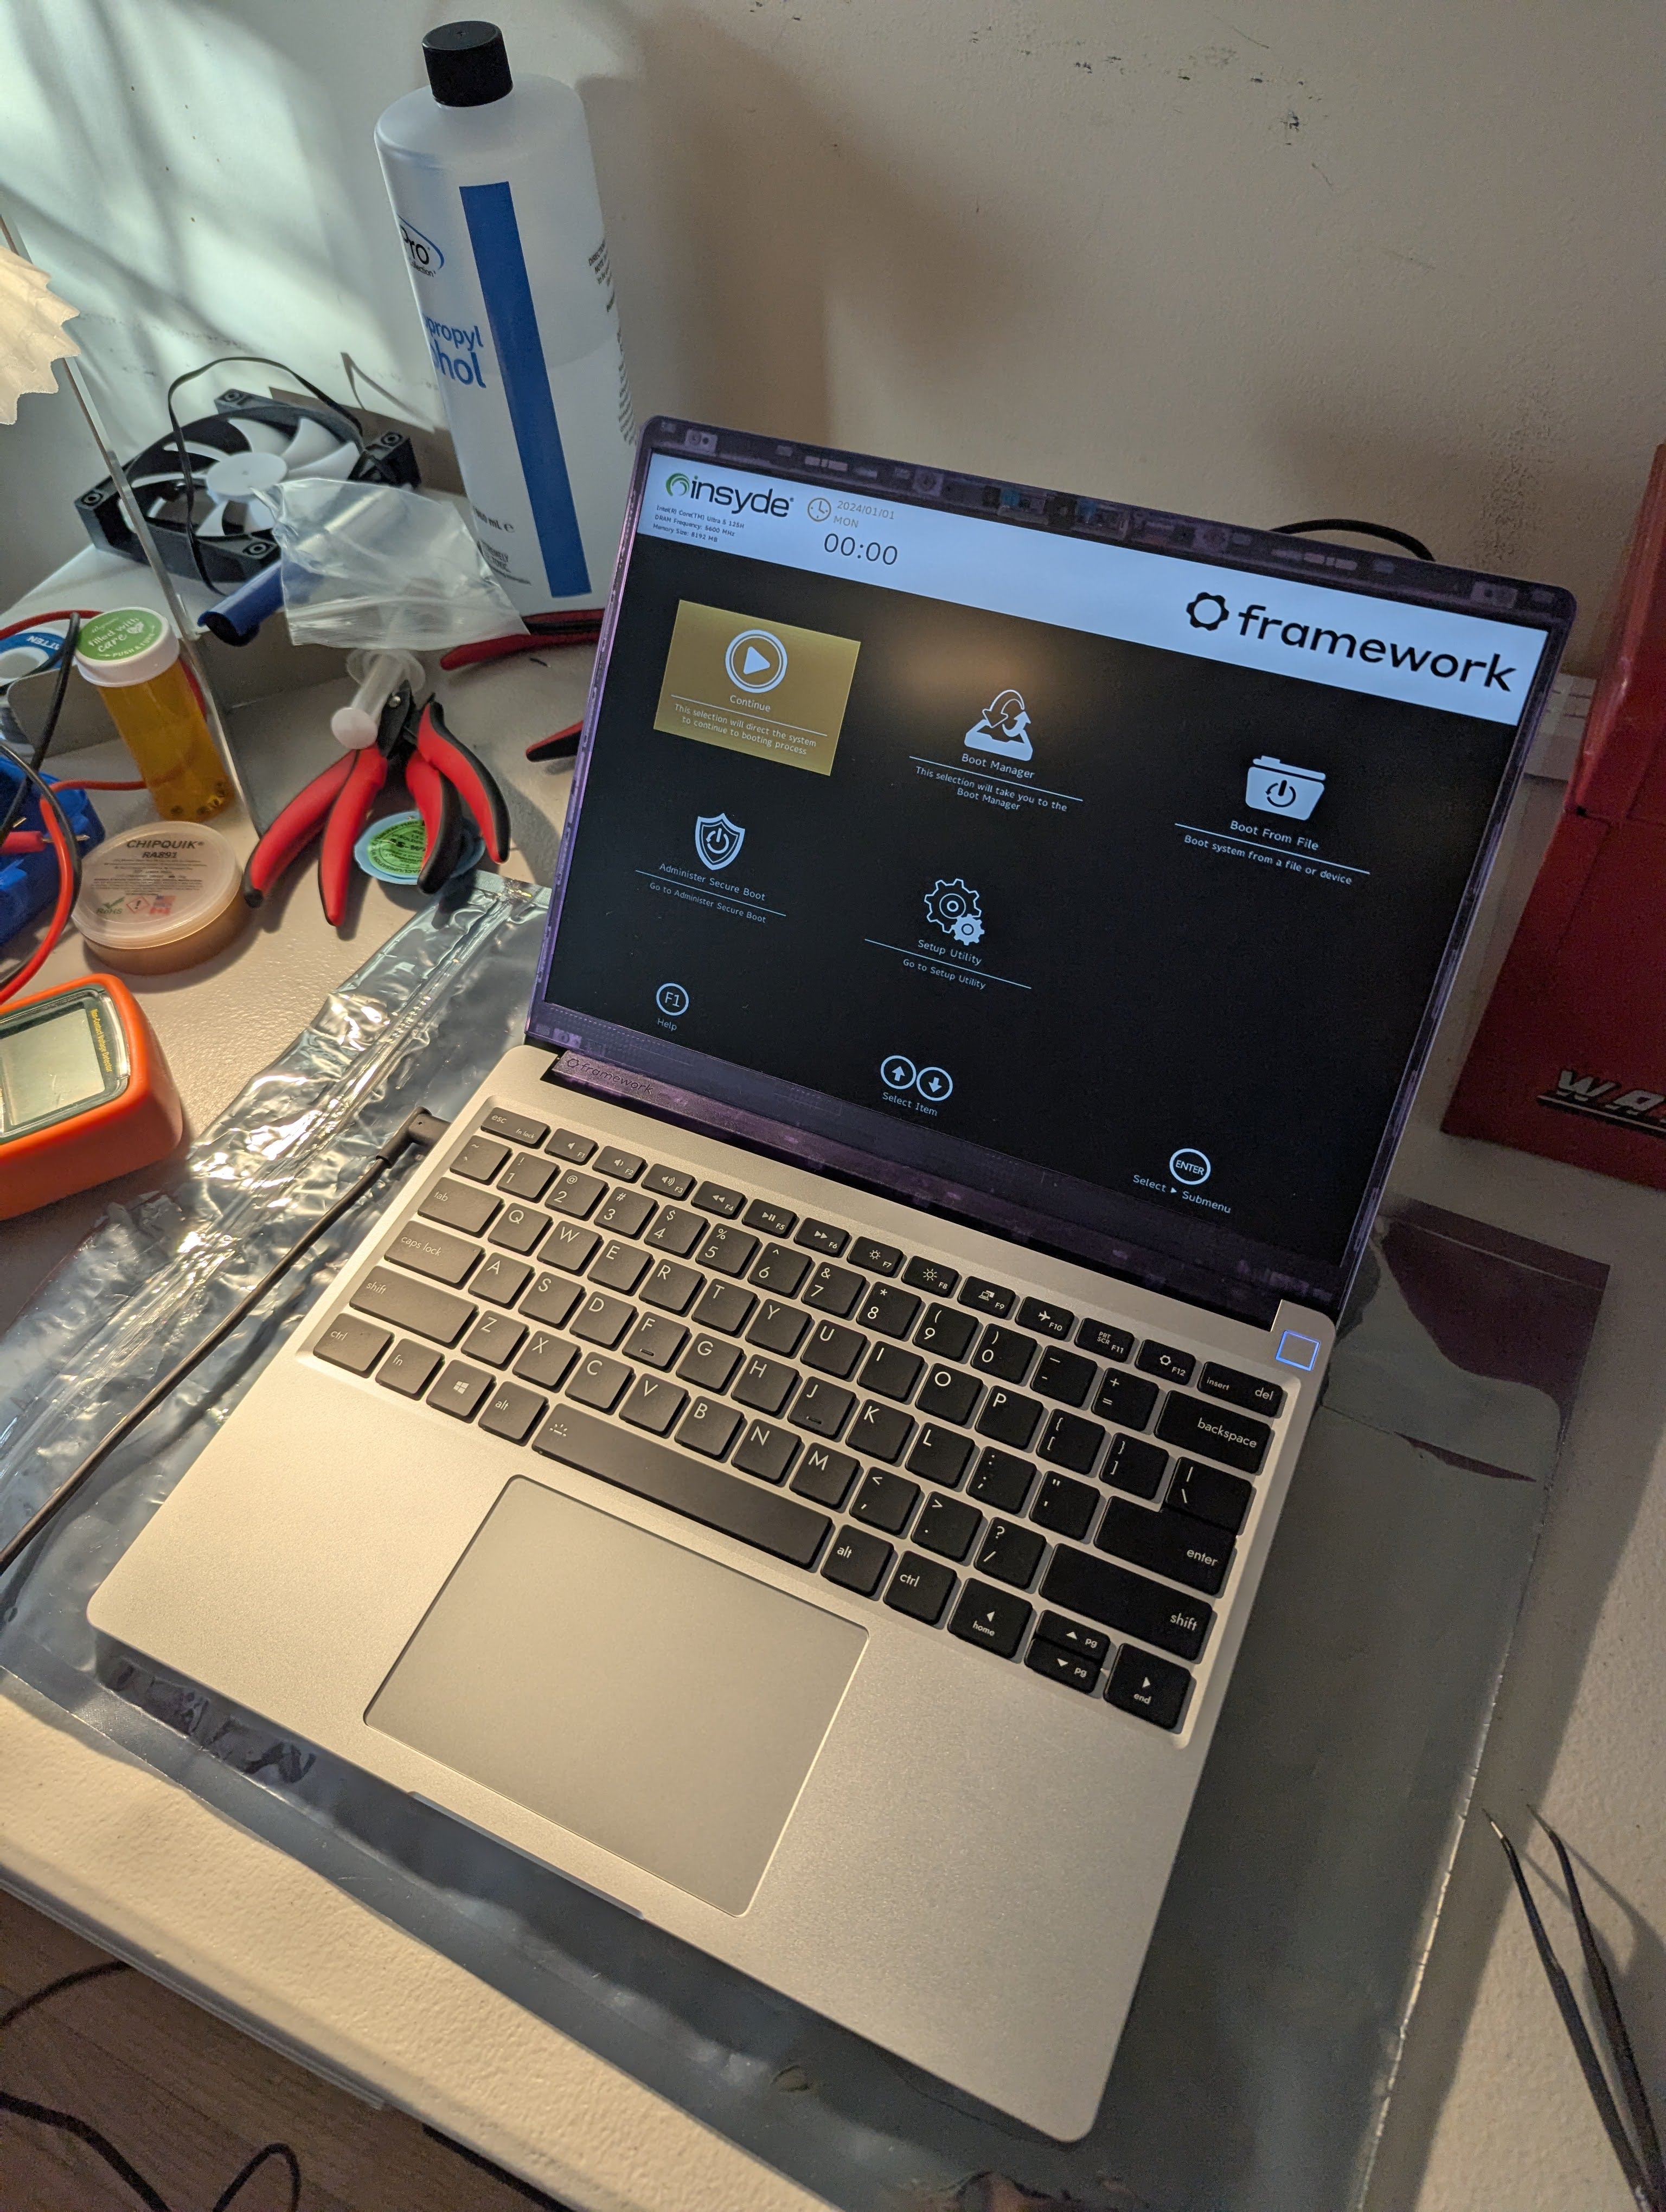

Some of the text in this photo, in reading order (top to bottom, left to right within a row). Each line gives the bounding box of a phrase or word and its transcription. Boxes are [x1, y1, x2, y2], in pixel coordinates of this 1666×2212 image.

[425, 315, 484, 351] propyl
[689, 475, 790, 517] insyde
[837, 500, 895, 520] 2024/01/01
[655, 515, 671, 523] DRAM
[707, 516, 720, 524] Ultra
[729, 520, 745, 529] 125H
[833, 516, 859, 529] MON
[653, 523, 675, 534] Memory
[691, 532, 706, 540] 8192
[824, 533, 898, 565] 00:00
[1238, 604, 1516, 692] framework
[729, 695, 771, 712] Continue
[675, 704, 817, 747] This selection will direct the system
[682, 716, 691, 724] to
[694, 719, 727, 735] continue
[742, 731, 772, 748] booting
[775, 741, 807, 755] process
[961, 753, 1035, 779] Boot Manager
[916, 766, 1067, 812] This selection will take you to the
[957, 788, 1021, 811] Boot Manager
[1230, 820, 1319, 851] Boot From File
[126, 840, 197, 849] CHIPQUIK
[1184, 834, 1353, 885] Boot system from a file or device
[659, 863, 766, 901] Administer Secure Boot
[650, 882, 766, 923] Go to Administer Secure Boot
[918, 939, 982, 966] Setup Utility
[903, 959, 986, 990] Go to Setup Utility
[665, 992, 680, 1007] F1
[657, 1018, 677, 1032] Help
[90, 1008, 113, 1073] Non-Contact Voltage Detector
[581, 1063, 653, 1094] framework
[882, 1092, 938, 1116] Select Item
[1556, 1070, 1666, 1124] WA
[492, 1114, 507, 1124] esc
[523, 1130, 535, 1139] lock
[1175, 1160, 1205, 1175] ENTER
[434, 1191, 448, 1201] tab
[553, 1191, 567, 1203] 2
[1133, 1174, 1231, 1213] Select Submenu
[509, 1210, 524, 1224] Q
[604, 1209, 616, 1220] 3
[559, 1226, 580, 1243] W
[654, 1227, 667, 1239] 4
[401, 1235, 443, 1256] caps lock
[606, 1245, 620, 1259] E
[704, 1246, 719, 1258] 5
[486, 1260, 501, 1274] A
[657, 1265, 671, 1280] R
[759, 1266, 770, 1278] 6
[366, 1281, 387, 1295] shift
[538, 1278, 552, 1292] S
[811, 1284, 824, 1297] 7
[938, 1282, 948, 1290] F8
[588, 1297, 604, 1312] D
[995, 1302, 1005, 1310] F9
[867, 1306, 879, 1319] 8
[641, 1317, 656, 1332] F
[1048, 1322, 1063, 1332] F10
[331, 1330, 348, 1341] ctrl
[819, 1326, 835, 1341] U
[924, 1327, 935, 1340] 9
[1097, 1336, 1111, 1346] SCR
[1099, 1331, 1111, 1339] PRT
[1111, 1345, 1124, 1354] F11
[392, 1354, 403, 1366] fn
[587, 1360, 603, 1375] C
[749, 1360, 768, 1378] H
[1171, 1366, 1186, 1377] F12
[1206, 1377, 1230, 1391] insert
[992, 1392, 1007, 1407] P
[1254, 1387, 1274, 1401] del
[495, 1399, 509, 1411] alt
[693, 1403, 708, 1419] B
[864, 1405, 880, 1423] K
[750, 1426, 770, 1446] N
[1197, 1417, 1258, 1449] backspace
[808, 1451, 829, 1471] M
[836, 1546, 853, 1559] alt
[1186, 1548, 1218, 1567] enter
[899, 1572, 920, 1587] ctrl
[972, 1621, 995, 1636] home
[1170, 1612, 1197, 1631] shift
[1085, 1638, 1099, 1649] pg
[1074, 1667, 1087, 1677] pg
[1133, 1693, 1151, 1705] end
